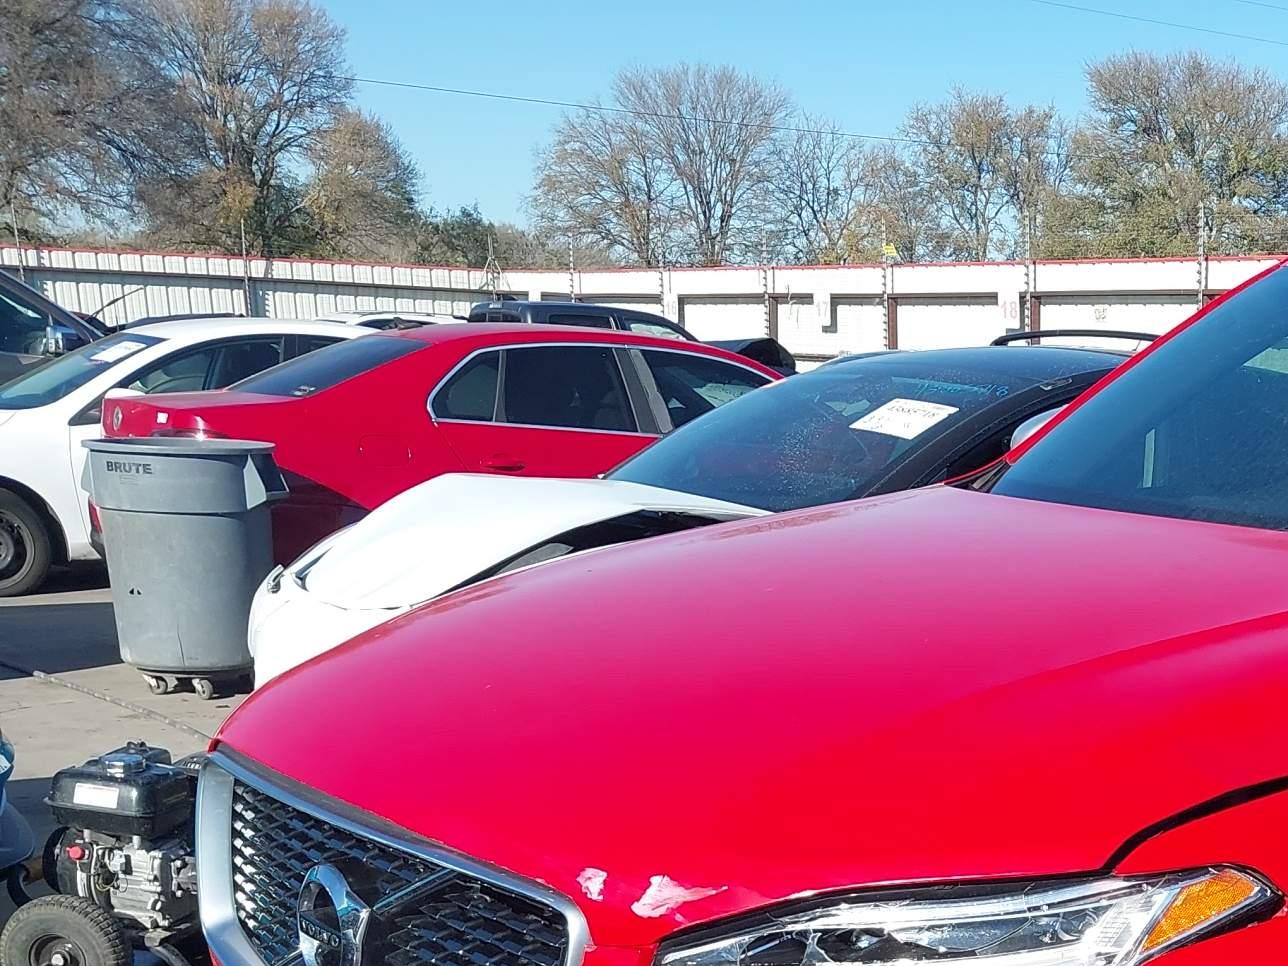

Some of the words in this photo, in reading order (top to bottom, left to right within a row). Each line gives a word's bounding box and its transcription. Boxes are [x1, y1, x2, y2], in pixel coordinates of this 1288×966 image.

[1000, 301, 1018, 320] 18
[105, 460, 153, 475] BRUTE
[302, 919, 339, 947] VOLVO
